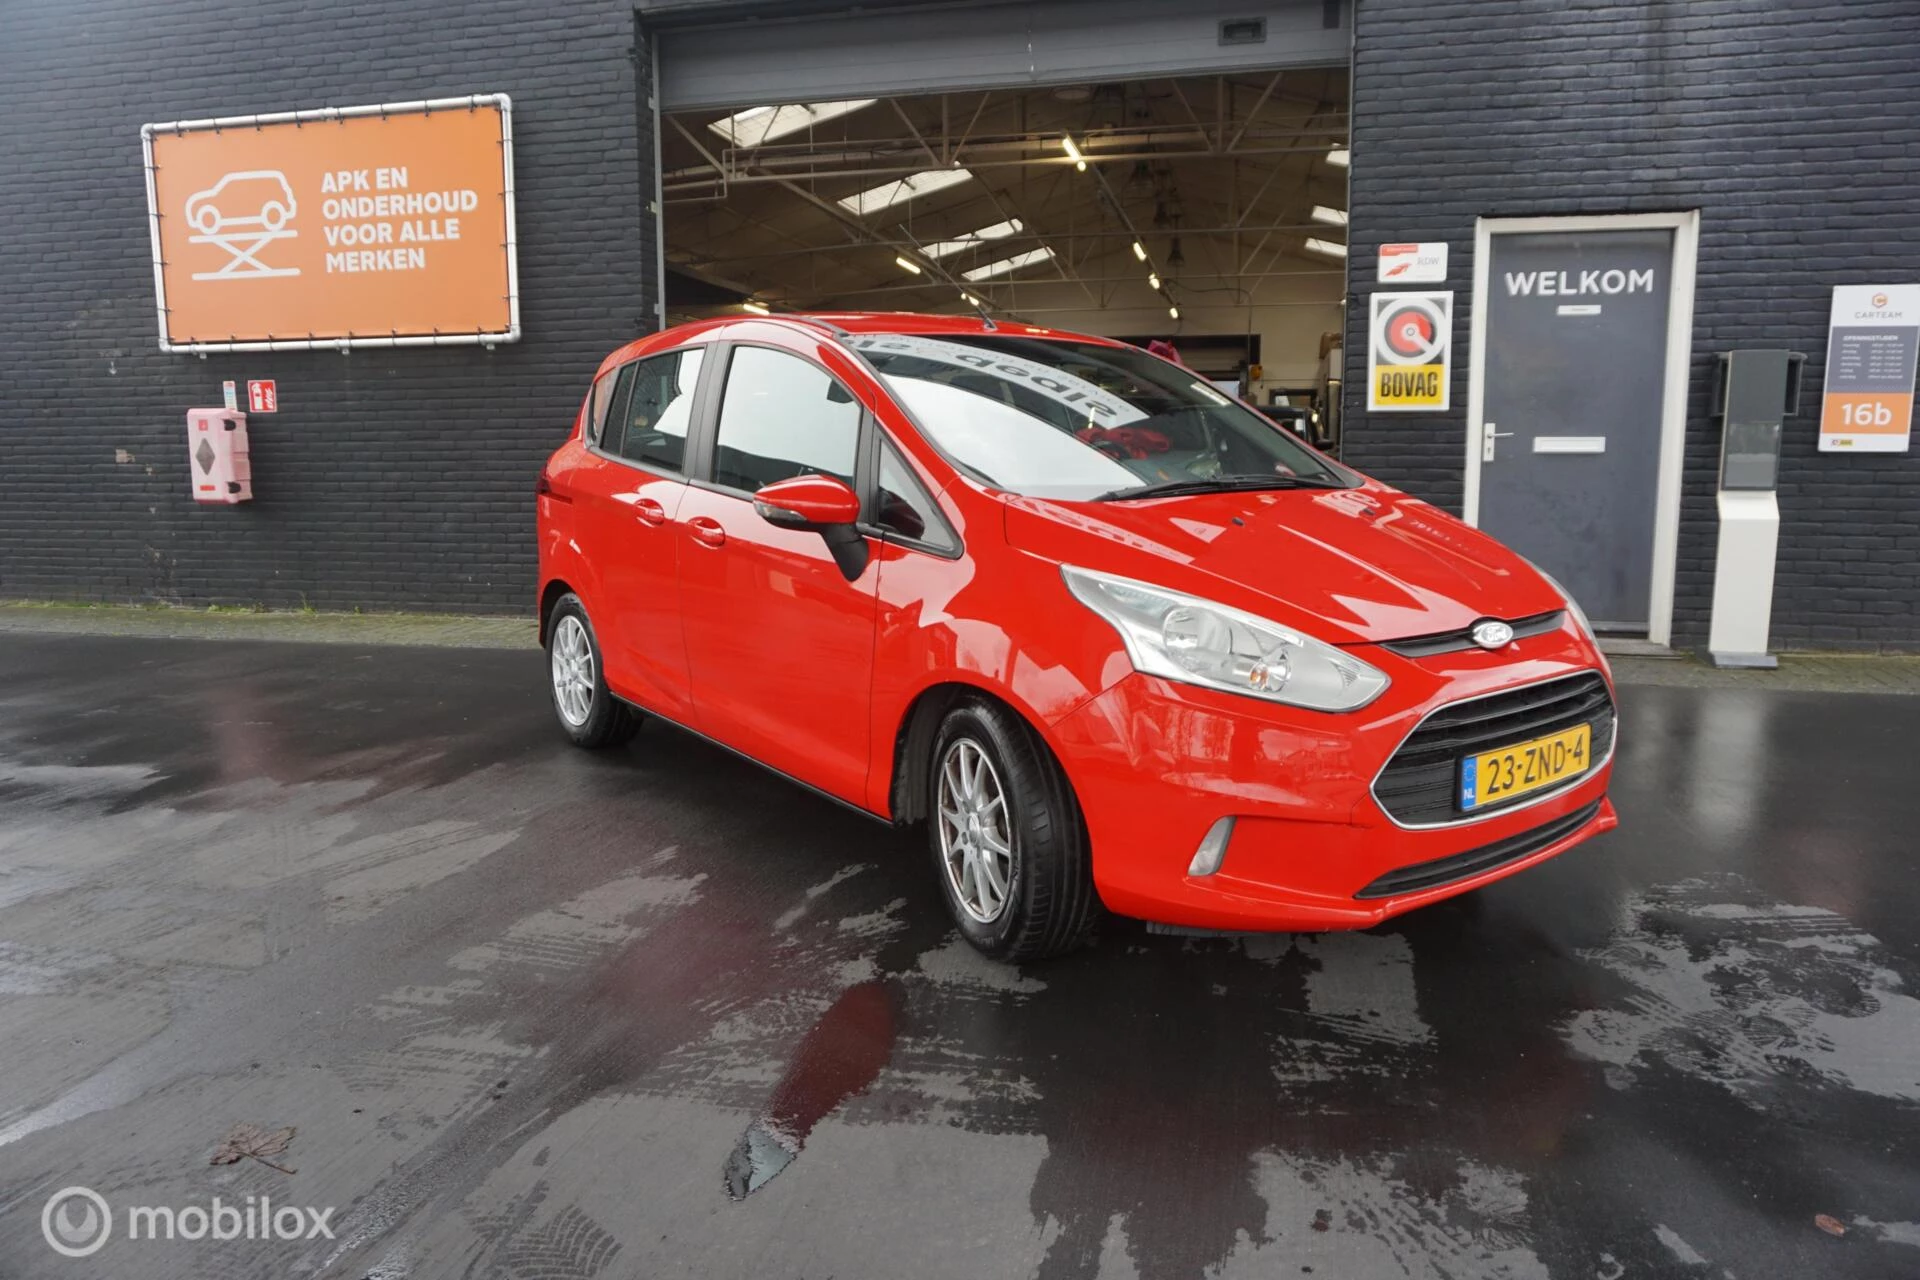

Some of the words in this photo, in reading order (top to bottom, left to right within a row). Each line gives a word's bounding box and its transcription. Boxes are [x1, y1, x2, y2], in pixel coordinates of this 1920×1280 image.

[321, 169, 370, 193] APK
[375, 167, 408, 189] EN
[322, 190, 478, 220] ONDERHOUD
[324, 222, 393, 247] VOOR
[399, 218, 461, 242] ALLE
[326, 248, 426, 273] MERKEN
[1504, 269, 1654, 296] WELKOM
[1380, 372, 1438, 397] BOVAG
[1841, 402, 1892, 425] 16b
[1487, 734, 1584, 794] 23-ZND-4
[1463, 788, 1474, 799] NL
